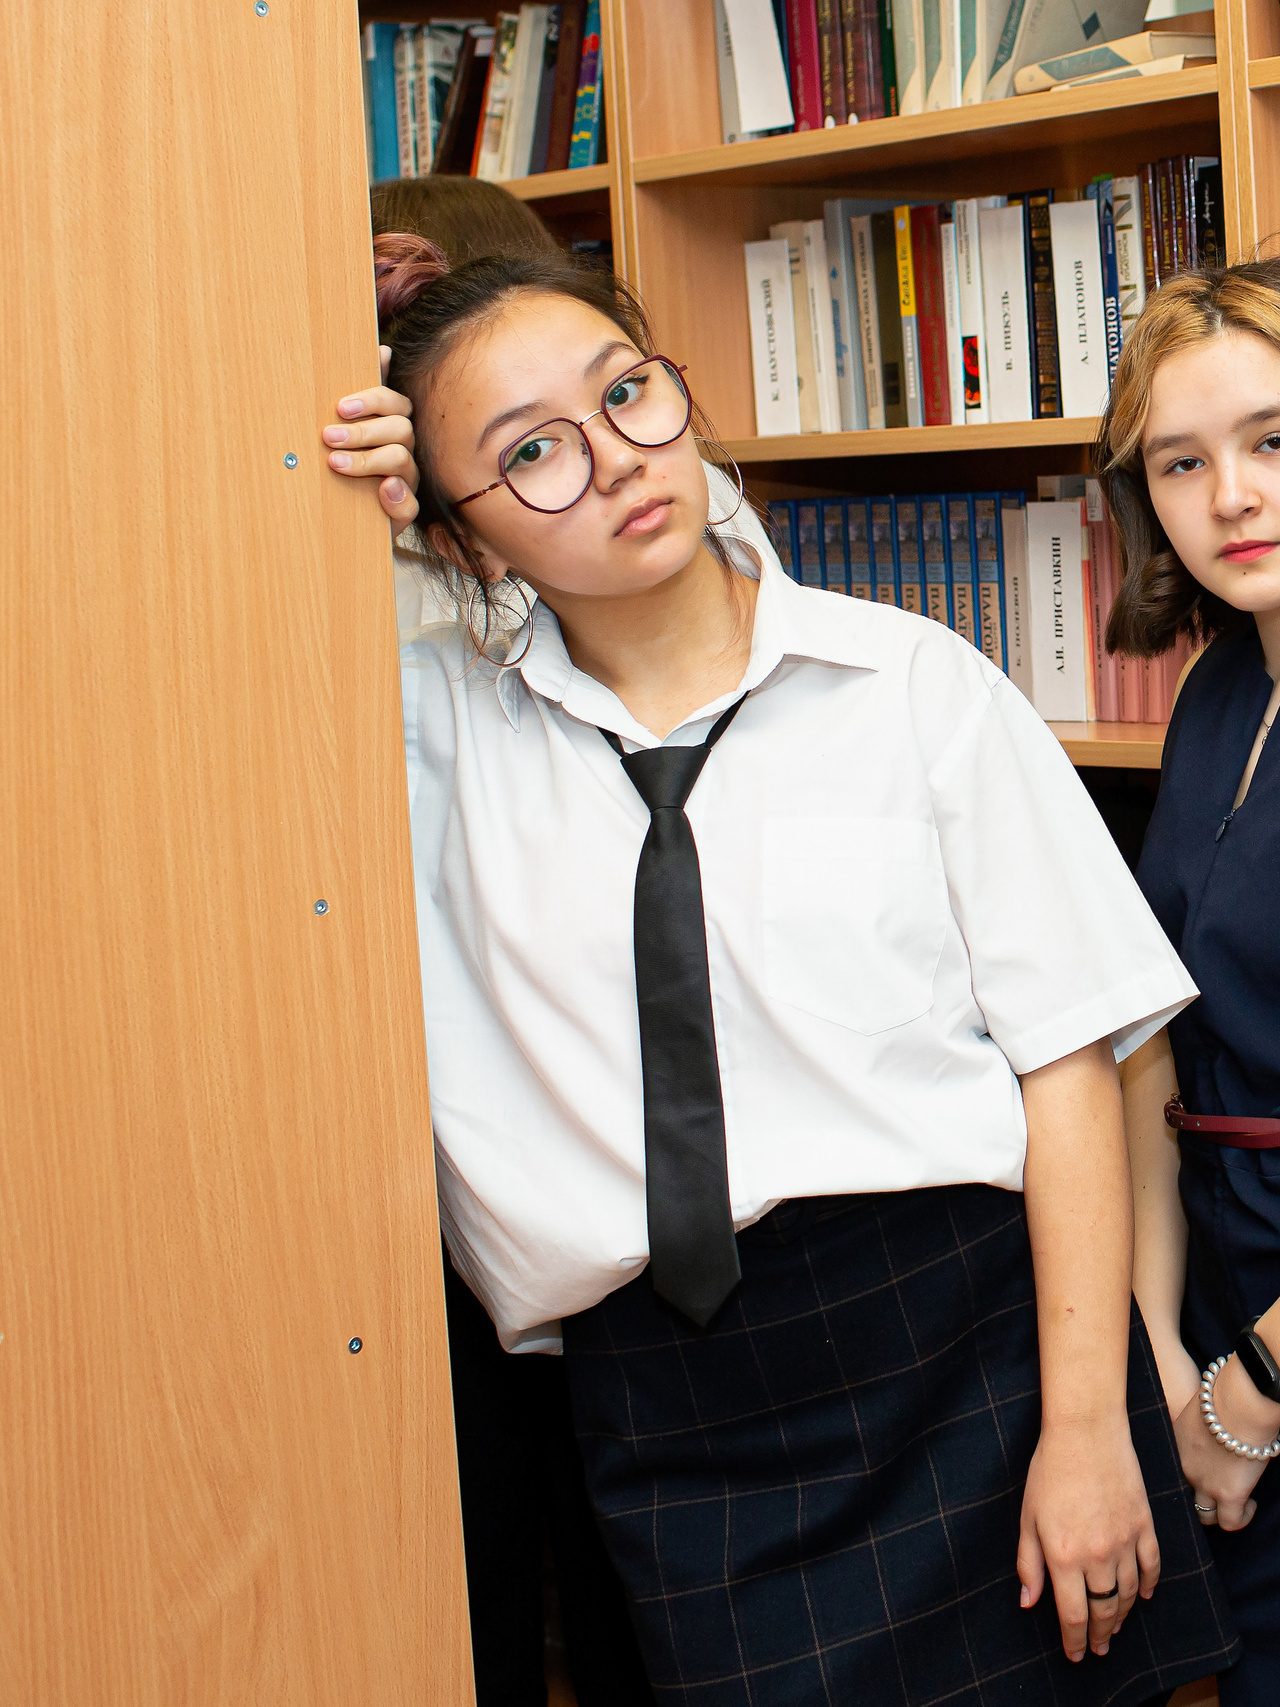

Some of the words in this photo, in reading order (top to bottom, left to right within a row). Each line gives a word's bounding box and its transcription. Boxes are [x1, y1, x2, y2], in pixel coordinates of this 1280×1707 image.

[761, 278, 778, 382] ПАУСТОВСКИЙ
[1000, 291, 1012, 351] ПИКУЛЬ
[1073, 260, 1088, 344] ПЛАТОНОВ
[1004, 358, 1013, 371] В.
[1079, 351, 1090, 366] А.
[770, 388, 780, 402] К.
[1012, 577, 1021, 647] ПОЛЕВОЙ
[1051, 536, 1064, 638] ПРИСТАВКИН
